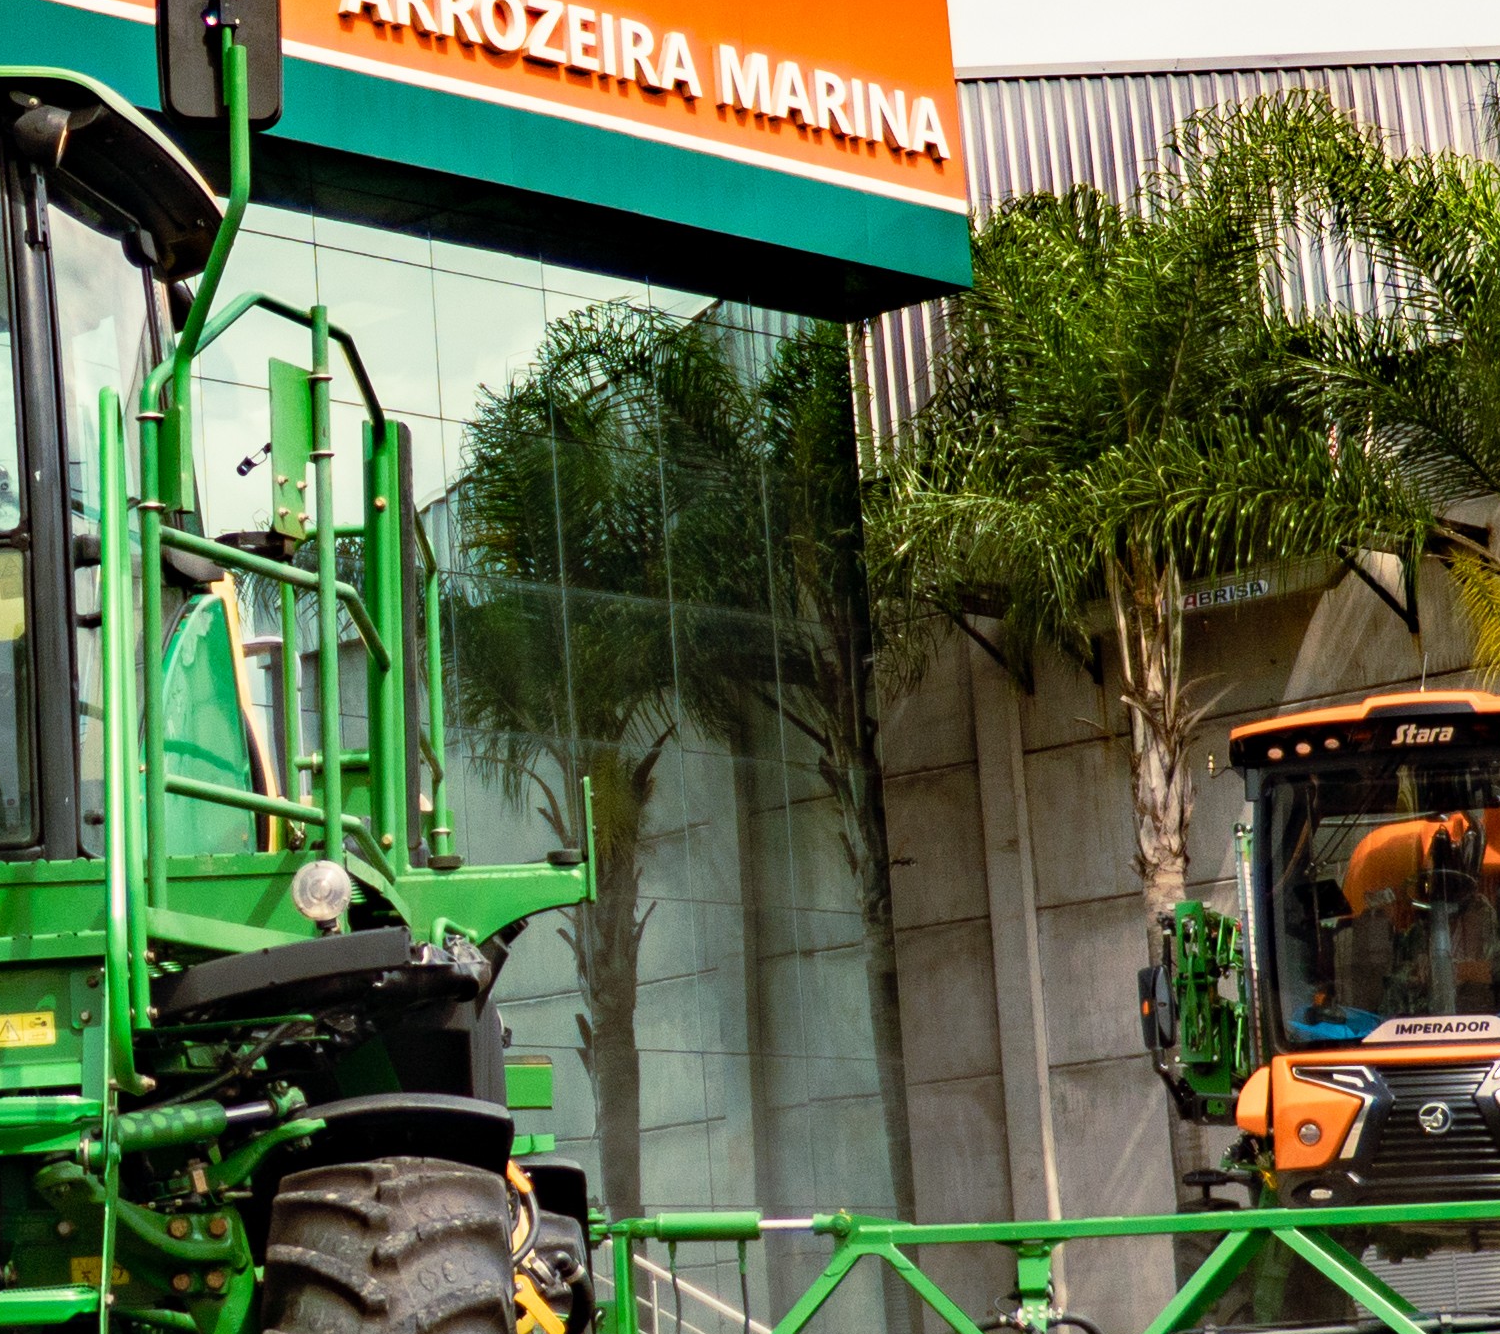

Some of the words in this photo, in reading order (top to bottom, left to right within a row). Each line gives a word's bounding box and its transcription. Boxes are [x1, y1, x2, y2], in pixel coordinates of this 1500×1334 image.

[715, 43, 951, 162] MARINA
[1391, 724, 1454, 744] Stara
[1395, 1021, 1490, 1035] IMPERADOR
